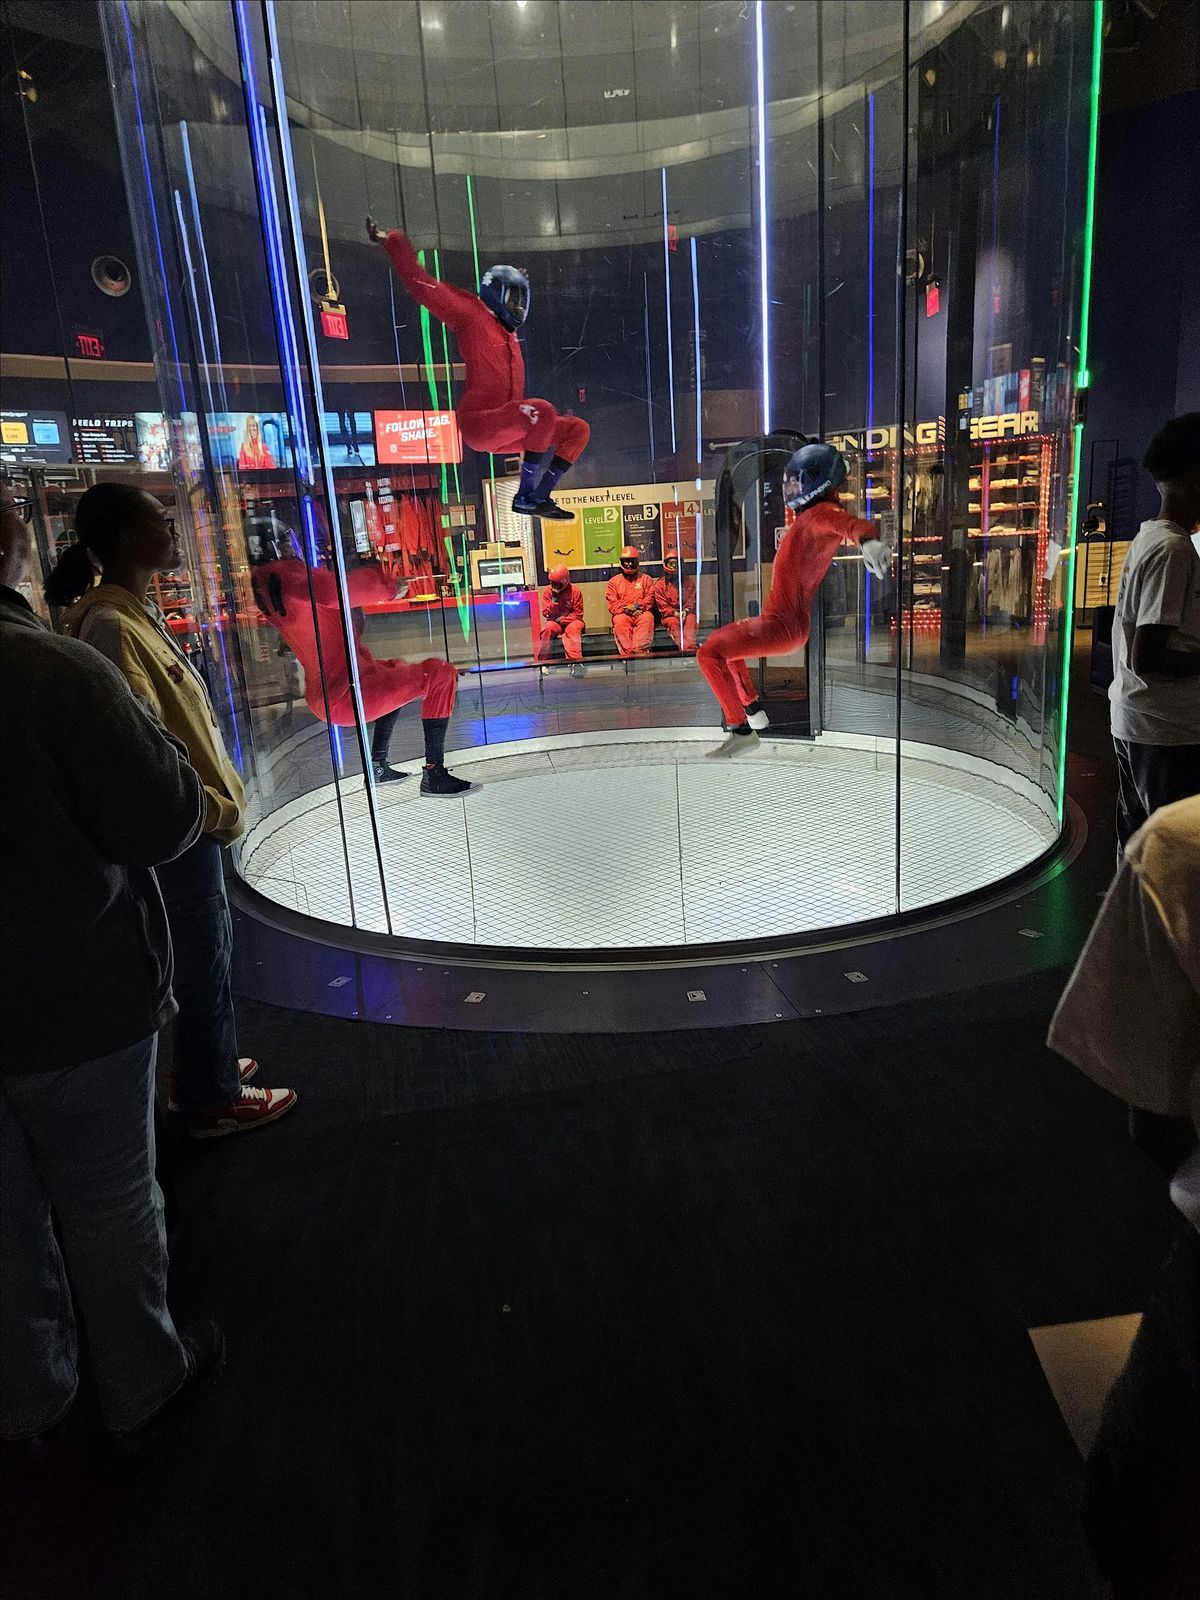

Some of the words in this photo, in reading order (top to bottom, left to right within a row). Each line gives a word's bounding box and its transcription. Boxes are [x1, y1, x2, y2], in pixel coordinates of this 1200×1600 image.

[386, 418, 425, 433] FOLLOW
[573, 496, 588, 504] THE
[589, 494, 609, 503] NEXT
[611, 492, 636, 502] LEVEL
[585, 516, 604, 524] LEVEL
[606, 509, 614, 521] 2
[624, 514, 643, 522] LEVEL
[646, 506, 653, 518] 3
[665, 511, 684, 519] LEVEL
[687, 503, 695, 515] 4
